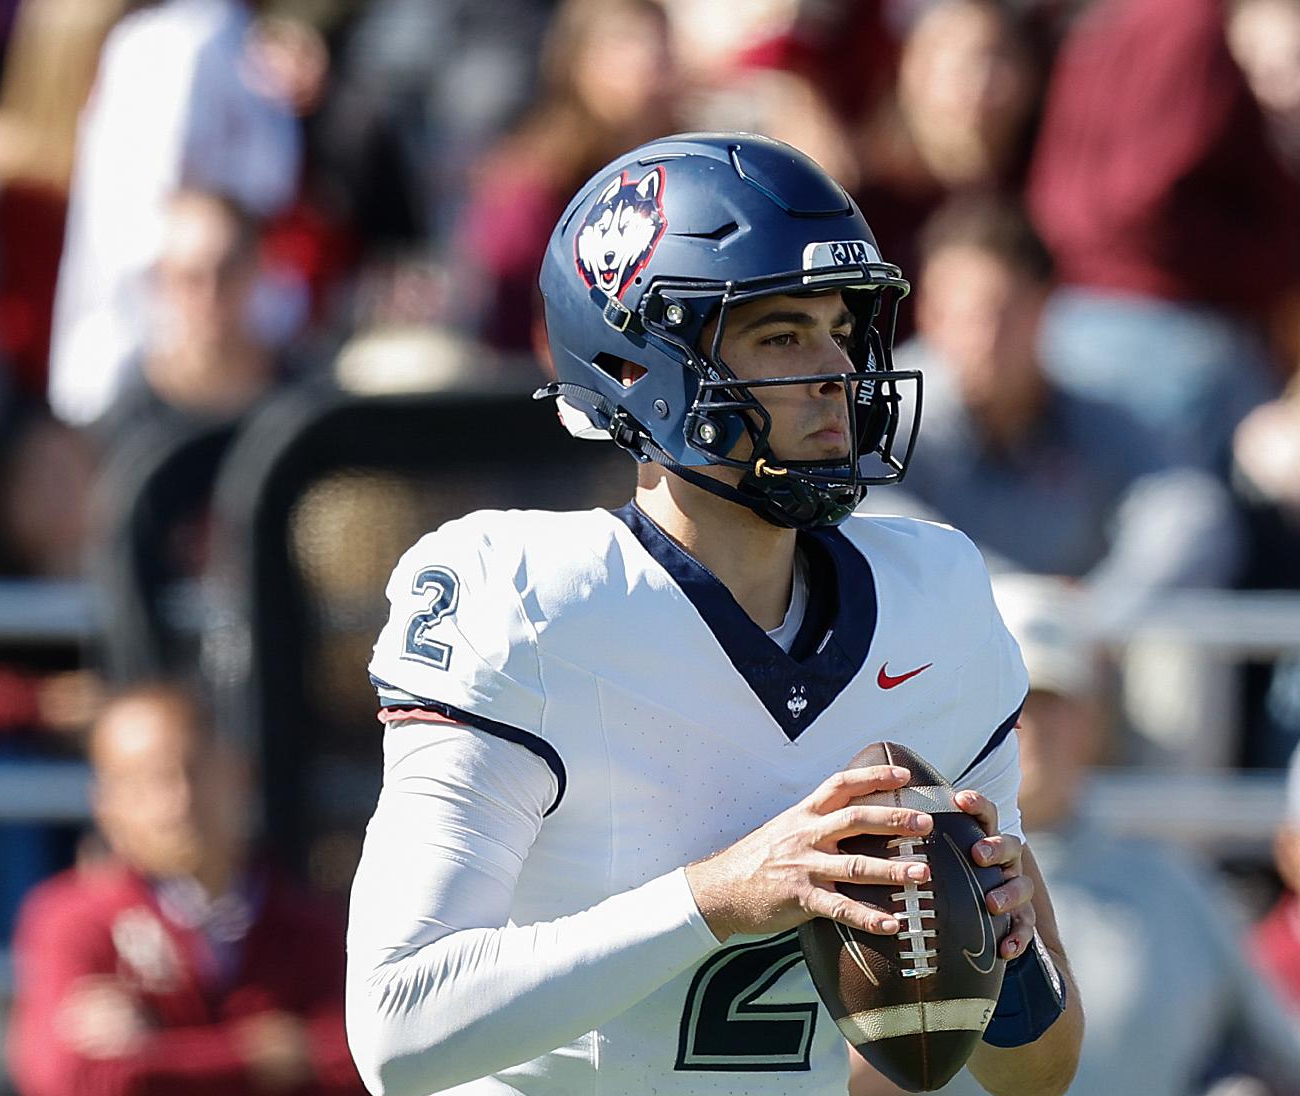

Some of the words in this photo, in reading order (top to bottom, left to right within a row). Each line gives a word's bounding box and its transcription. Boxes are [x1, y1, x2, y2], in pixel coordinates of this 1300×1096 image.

[857, 342, 878, 406] HUSKIE
[399, 564, 461, 672] 2
[673, 926, 819, 1072] 2
